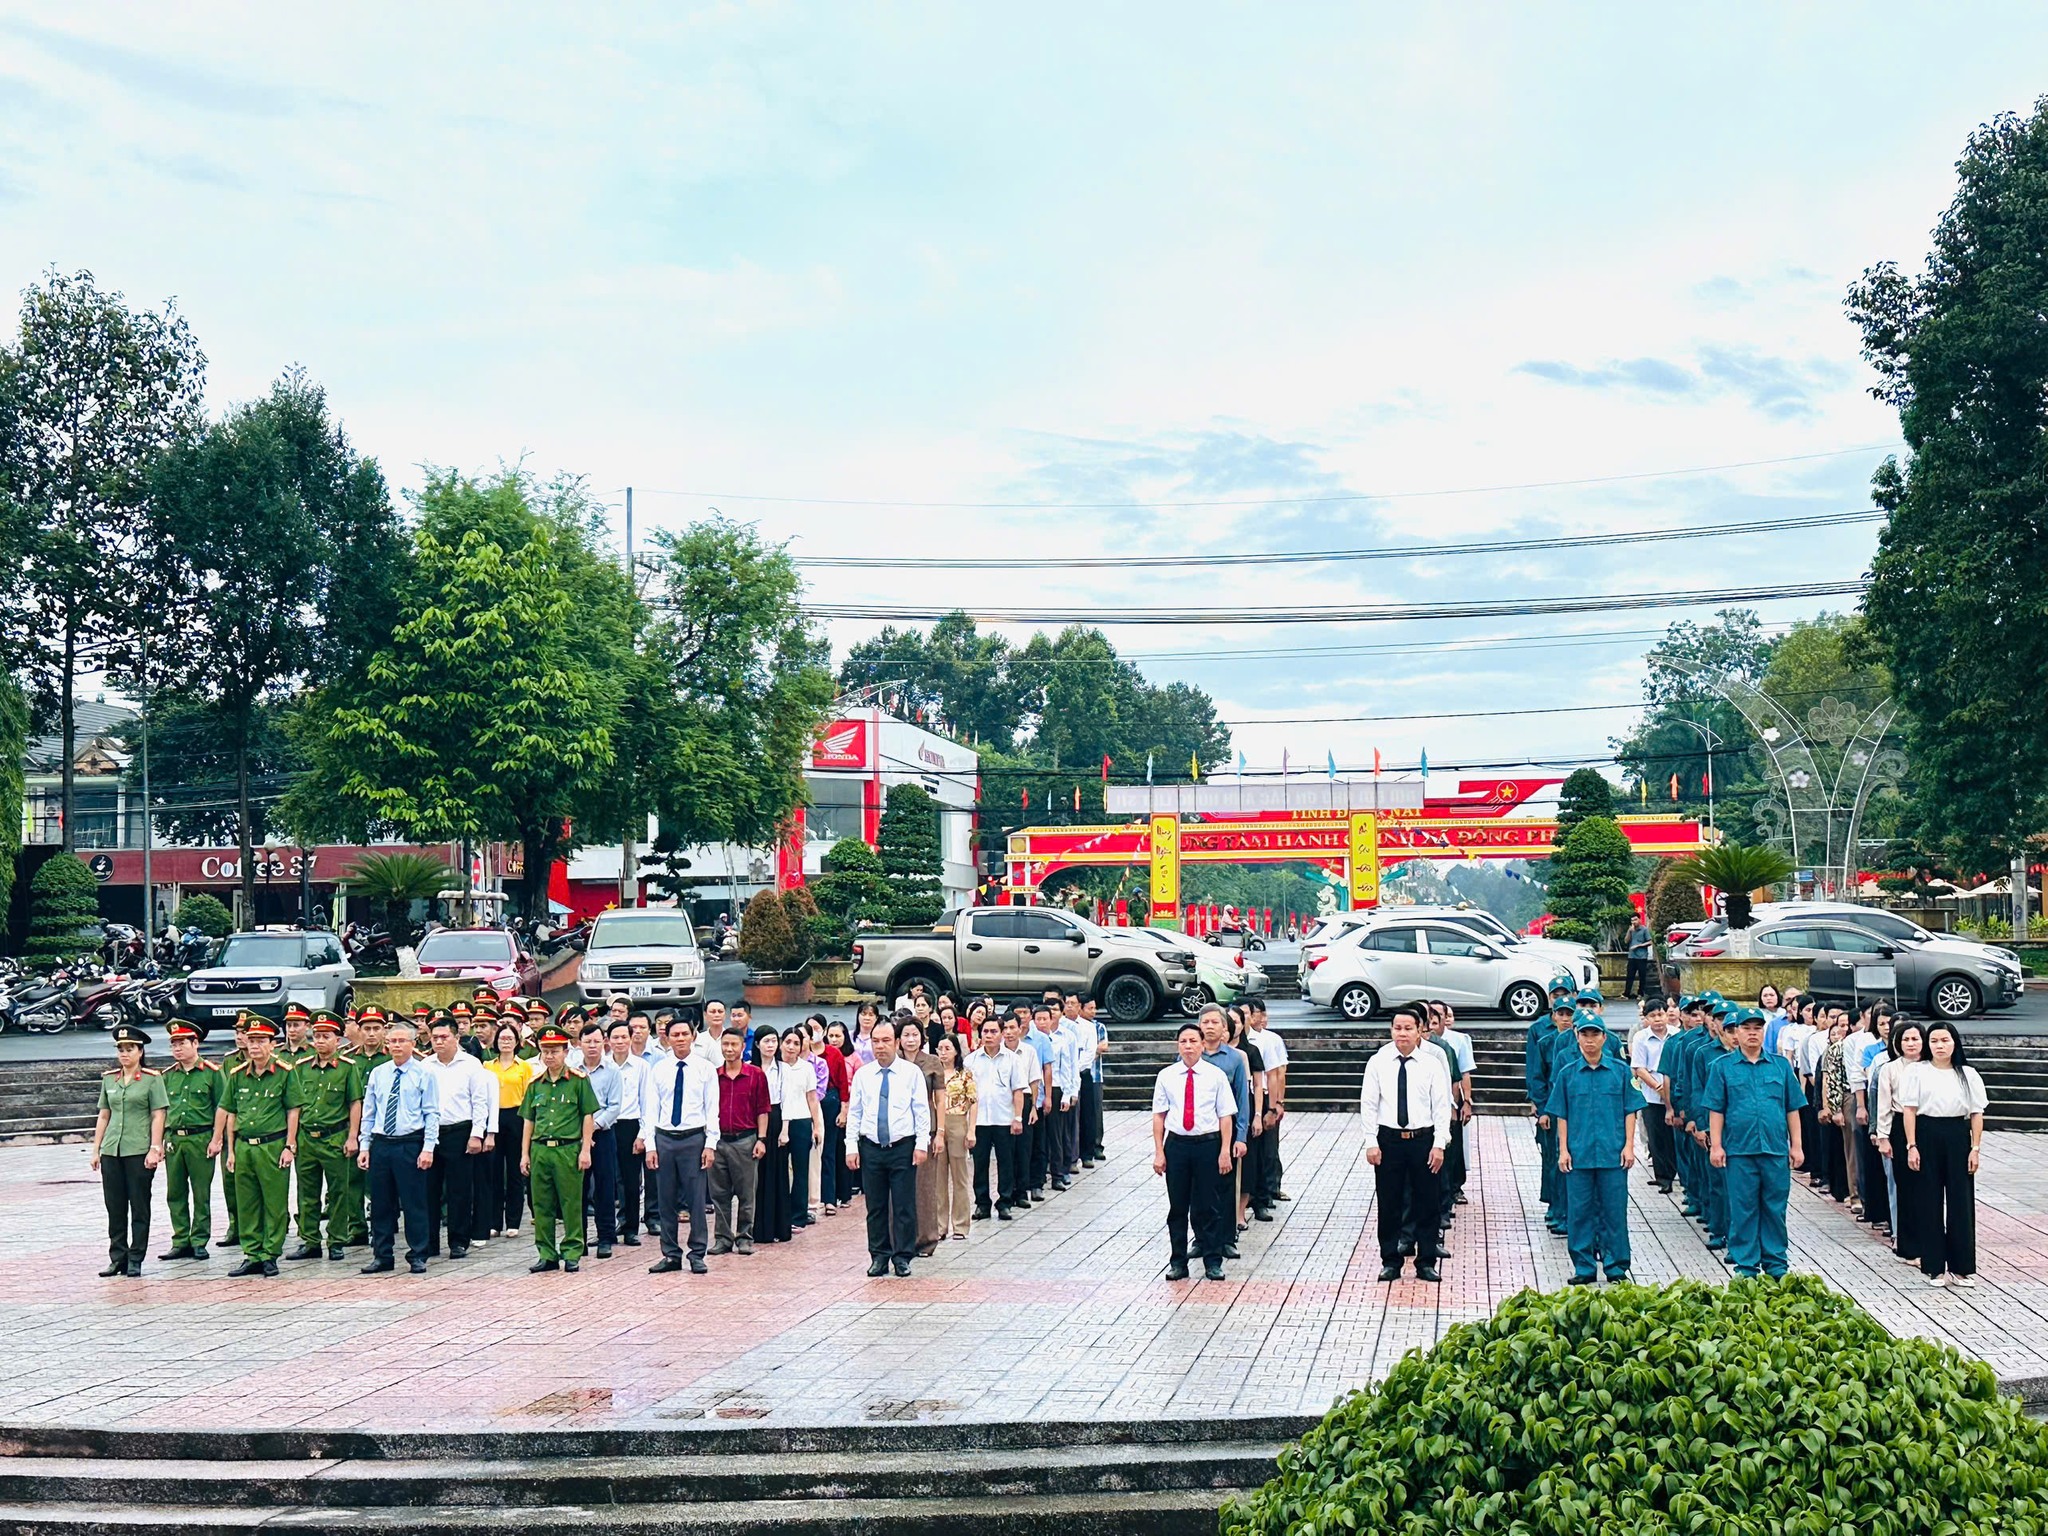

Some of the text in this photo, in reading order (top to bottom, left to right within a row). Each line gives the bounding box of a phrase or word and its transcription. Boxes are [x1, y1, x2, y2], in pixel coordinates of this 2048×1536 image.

[822, 753, 859, 761] HONDA
[1180, 834, 1219, 848] UNG
[1526, 829, 1557, 843] PH
[201, 856, 285, 878] Cofee
